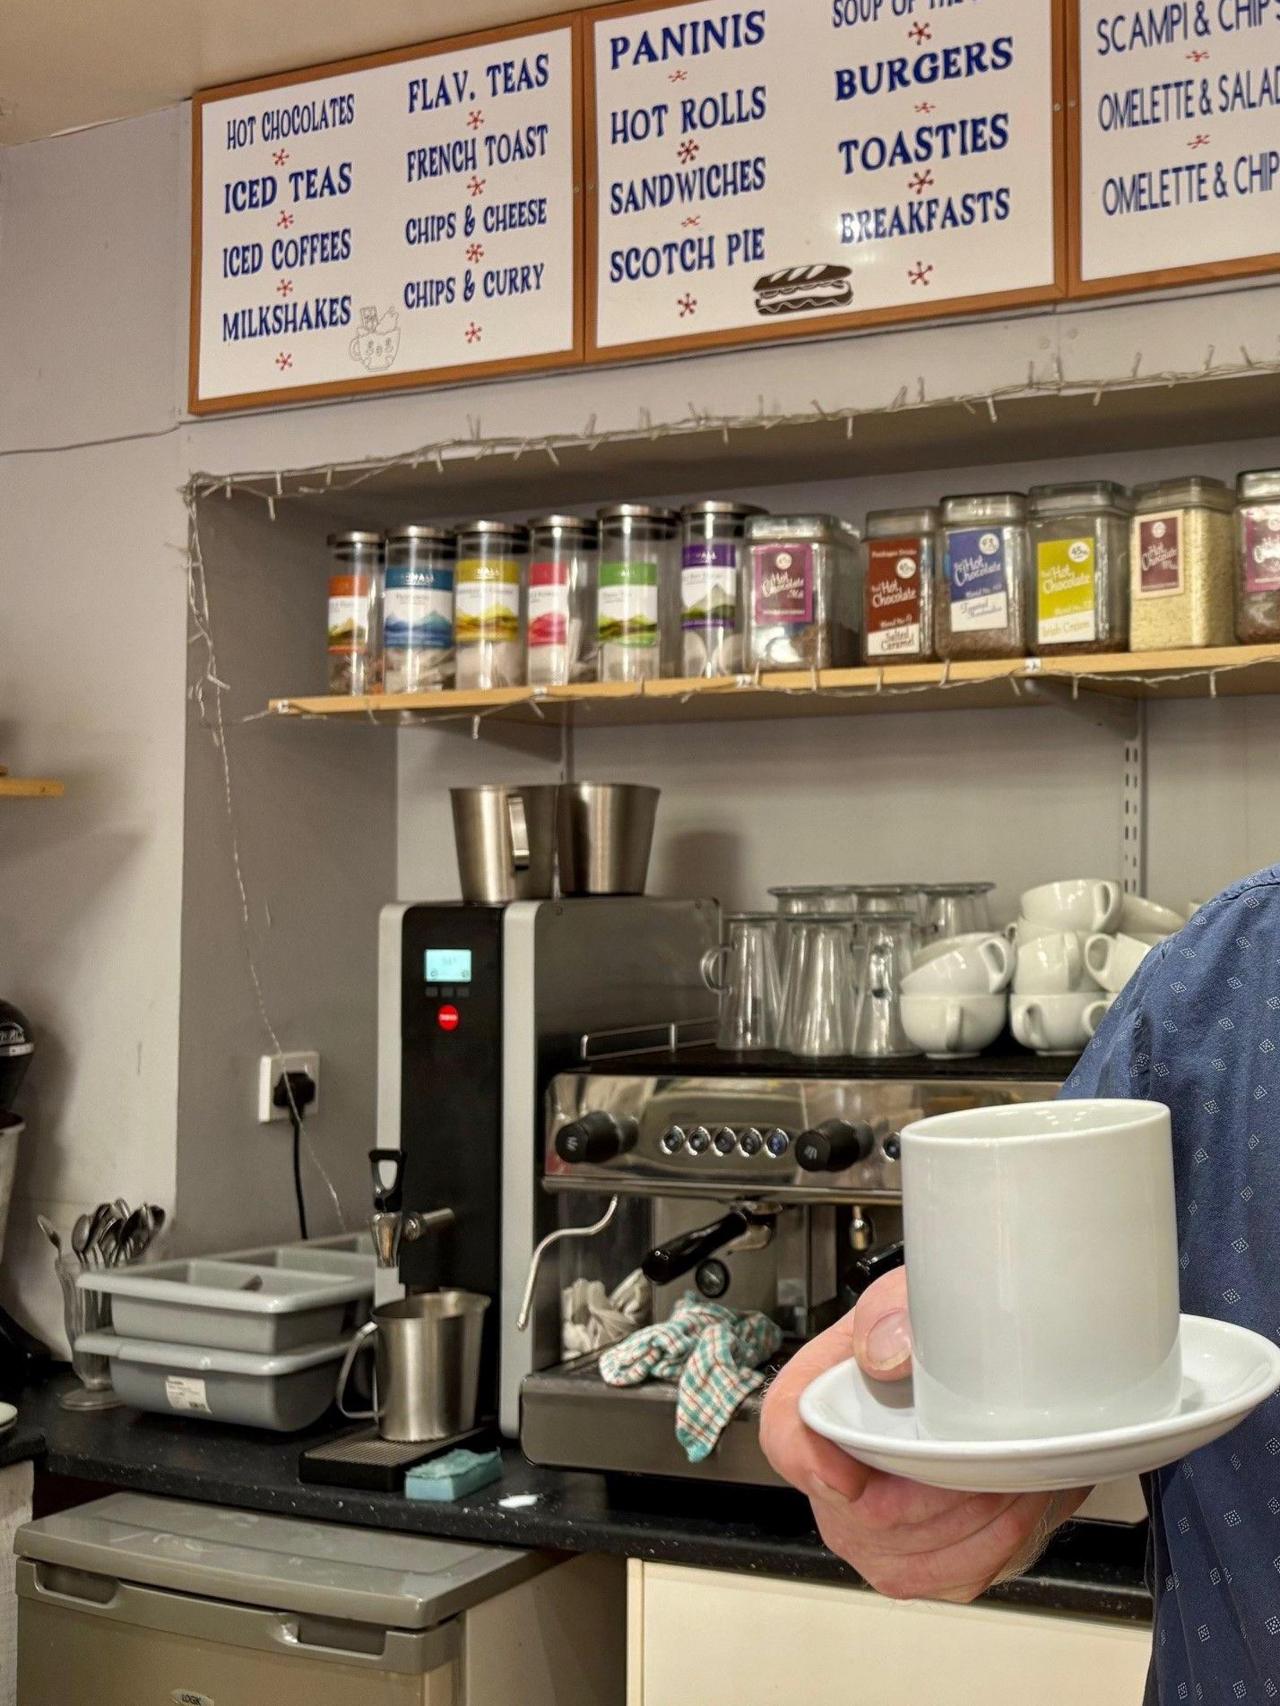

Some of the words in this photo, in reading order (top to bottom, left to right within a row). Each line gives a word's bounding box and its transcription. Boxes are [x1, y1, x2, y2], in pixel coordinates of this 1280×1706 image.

[610, 10, 766, 70] PANINIS
[832, 0, 882, 28] SOUP
[1097, 2, 1188, 56] SCAMPI
[1194, 0, 1211, 37] &
[407, 70, 476, 114] FLAV.
[486, 53, 549, 98] TEAS
[835, 36, 1014, 101] BURGERS
[226, 117, 257, 151] HOT
[262, 94, 355, 141] CHOCOLATES
[610, 104, 669, 146] HOT
[681, 86, 767, 134] ROLLS
[1099, 80, 1194, 131] OMELETTE
[1200, 78, 1213, 114] &
[406, 137, 477, 182] FRENCH
[484, 124, 549, 167] TOAST
[838, 113, 1010, 175] TOASTIES
[224, 177, 277, 214] ICED
[289, 162, 353, 203] TEAS
[610, 157, 767, 216] SANDWICHES
[1102, 162, 1208, 216] OMELETTE
[1212, 161, 1228, 197] &
[405, 213, 457, 245] CHIPS
[463, 204, 476, 237] &
[483, 198, 547, 232] CHEESE
[840, 187, 1011, 245] BREAKFASTS
[223, 243, 263, 279] ICED
[271, 228, 352, 271] COFFEES
[610, 233, 716, 283] SCOTCH
[727, 228, 765, 265] PIE
[404, 278, 455, 309] CHIPS
[463, 270, 475, 302] &
[483, 263, 545, 298] CURRY
[222, 296, 352, 342] MILKSHAKES
